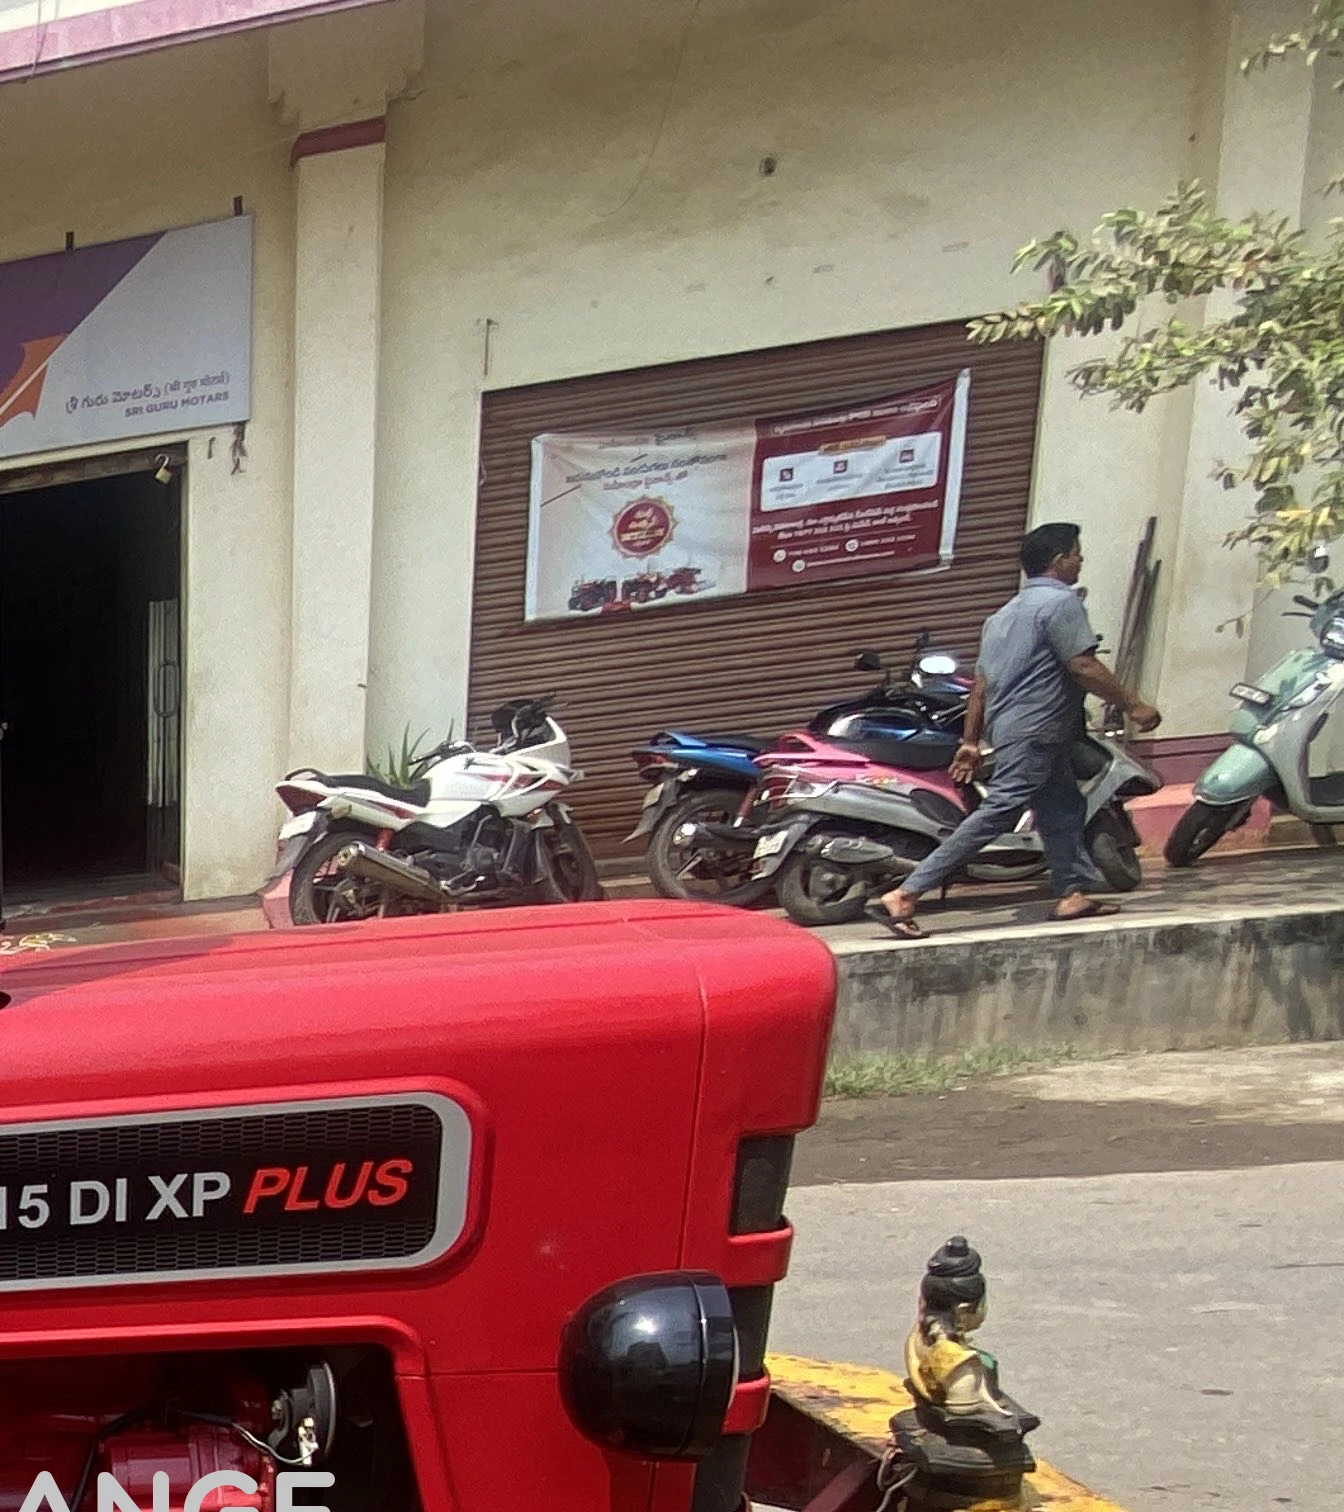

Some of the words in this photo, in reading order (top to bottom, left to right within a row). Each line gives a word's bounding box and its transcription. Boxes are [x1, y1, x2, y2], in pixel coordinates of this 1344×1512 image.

[124, 406, 143, 418] SRI
[146, 401, 178, 415] GURU
[69, 1178, 128, 1226] DI
[145, 1172, 231, 1220] XP
[243, 1159, 414, 1214] PLUS
